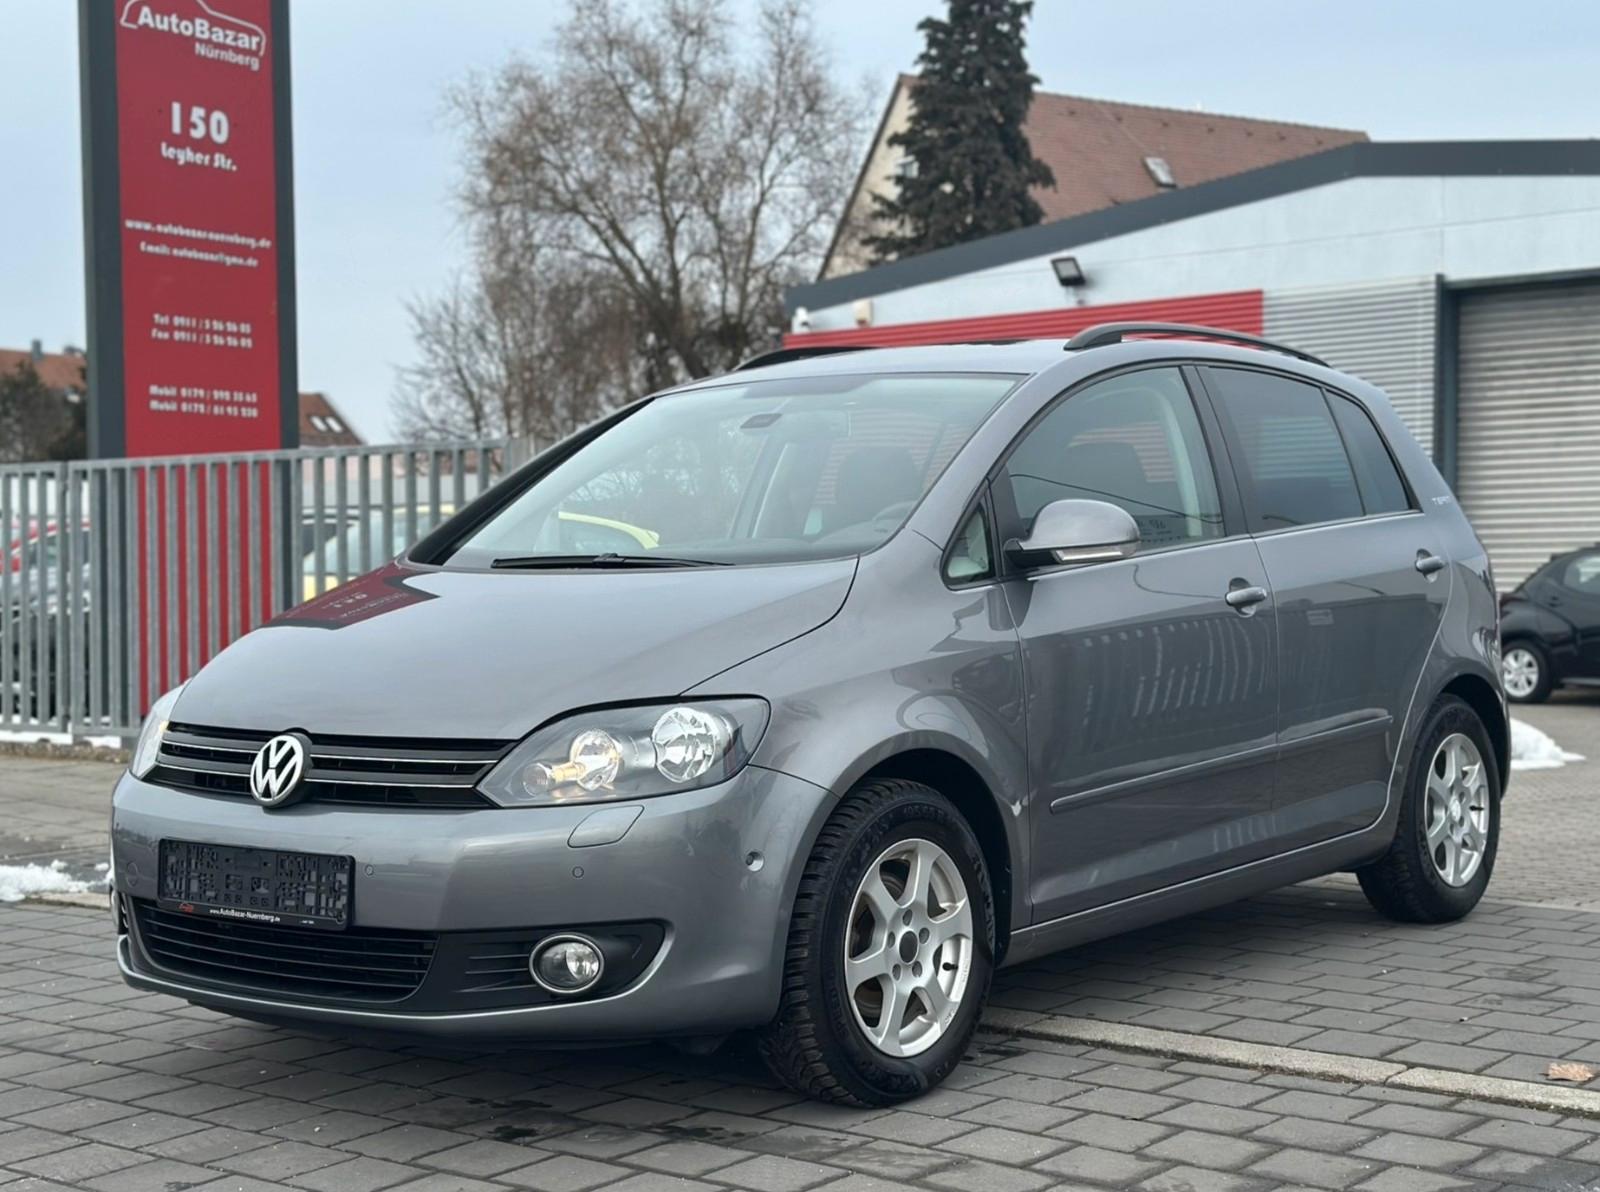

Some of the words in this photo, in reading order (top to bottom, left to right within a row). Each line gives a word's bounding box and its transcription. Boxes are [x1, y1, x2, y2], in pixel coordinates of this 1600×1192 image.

[138, 6, 260, 51] AutoBazar
[195, 42, 259, 71] Nürnberg
[212, 152, 238, 172] Str.
